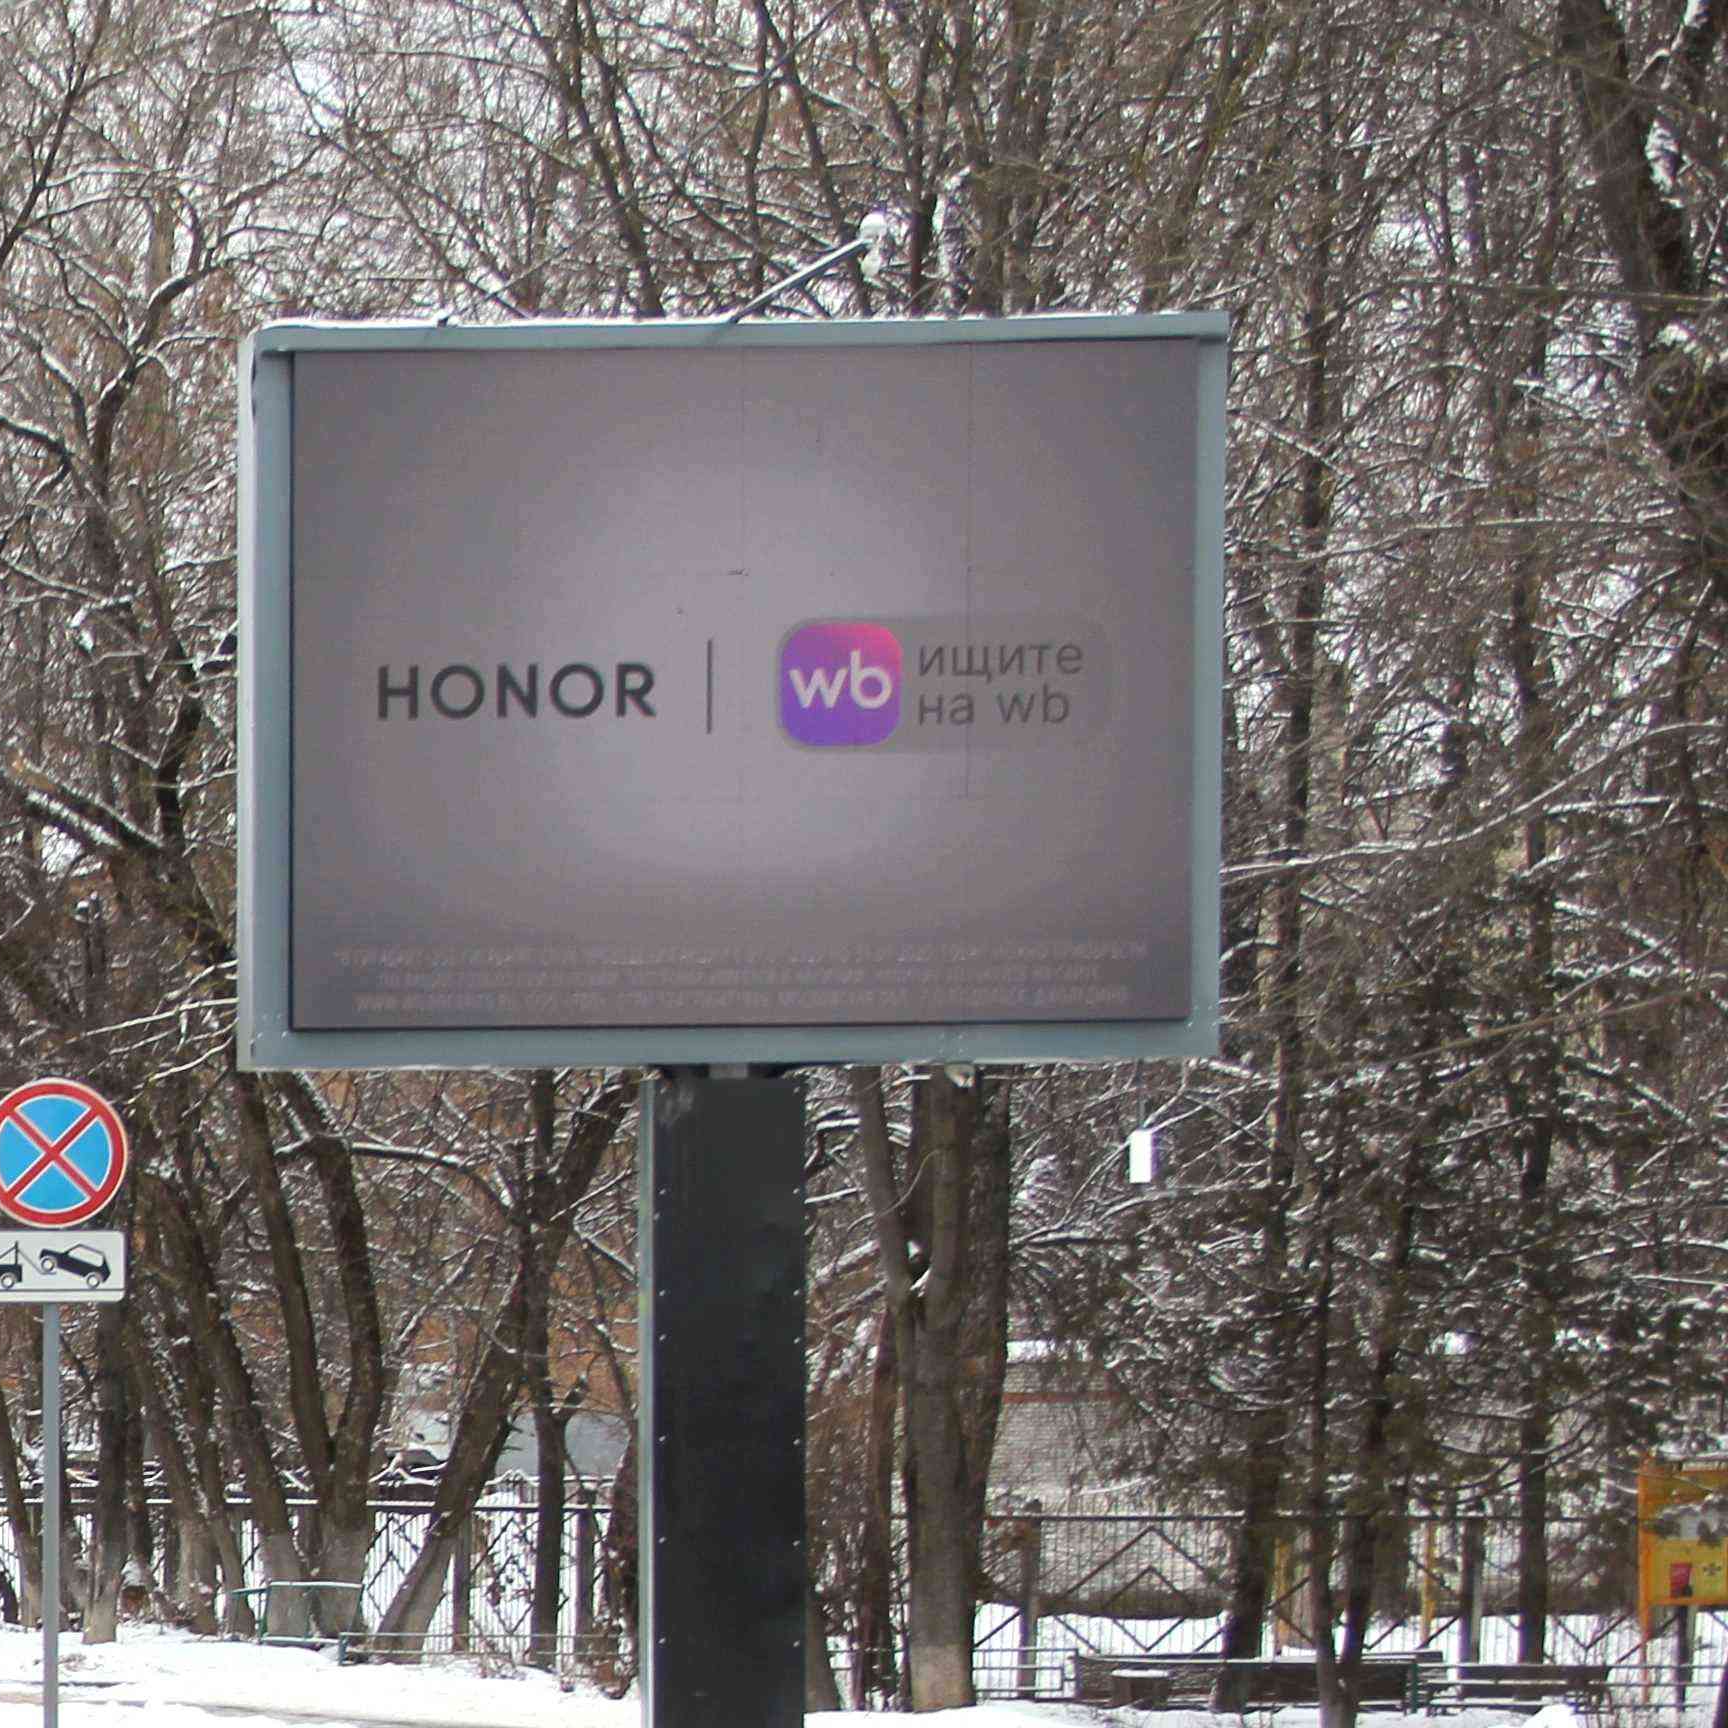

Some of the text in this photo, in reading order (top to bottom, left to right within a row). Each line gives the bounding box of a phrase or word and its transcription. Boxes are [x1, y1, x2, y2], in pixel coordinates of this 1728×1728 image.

[788, 648, 893, 710] wb
[917, 643, 1084, 683] ищите
[377, 662, 657, 721] HONOR
[917, 684, 1070, 726] на wb
